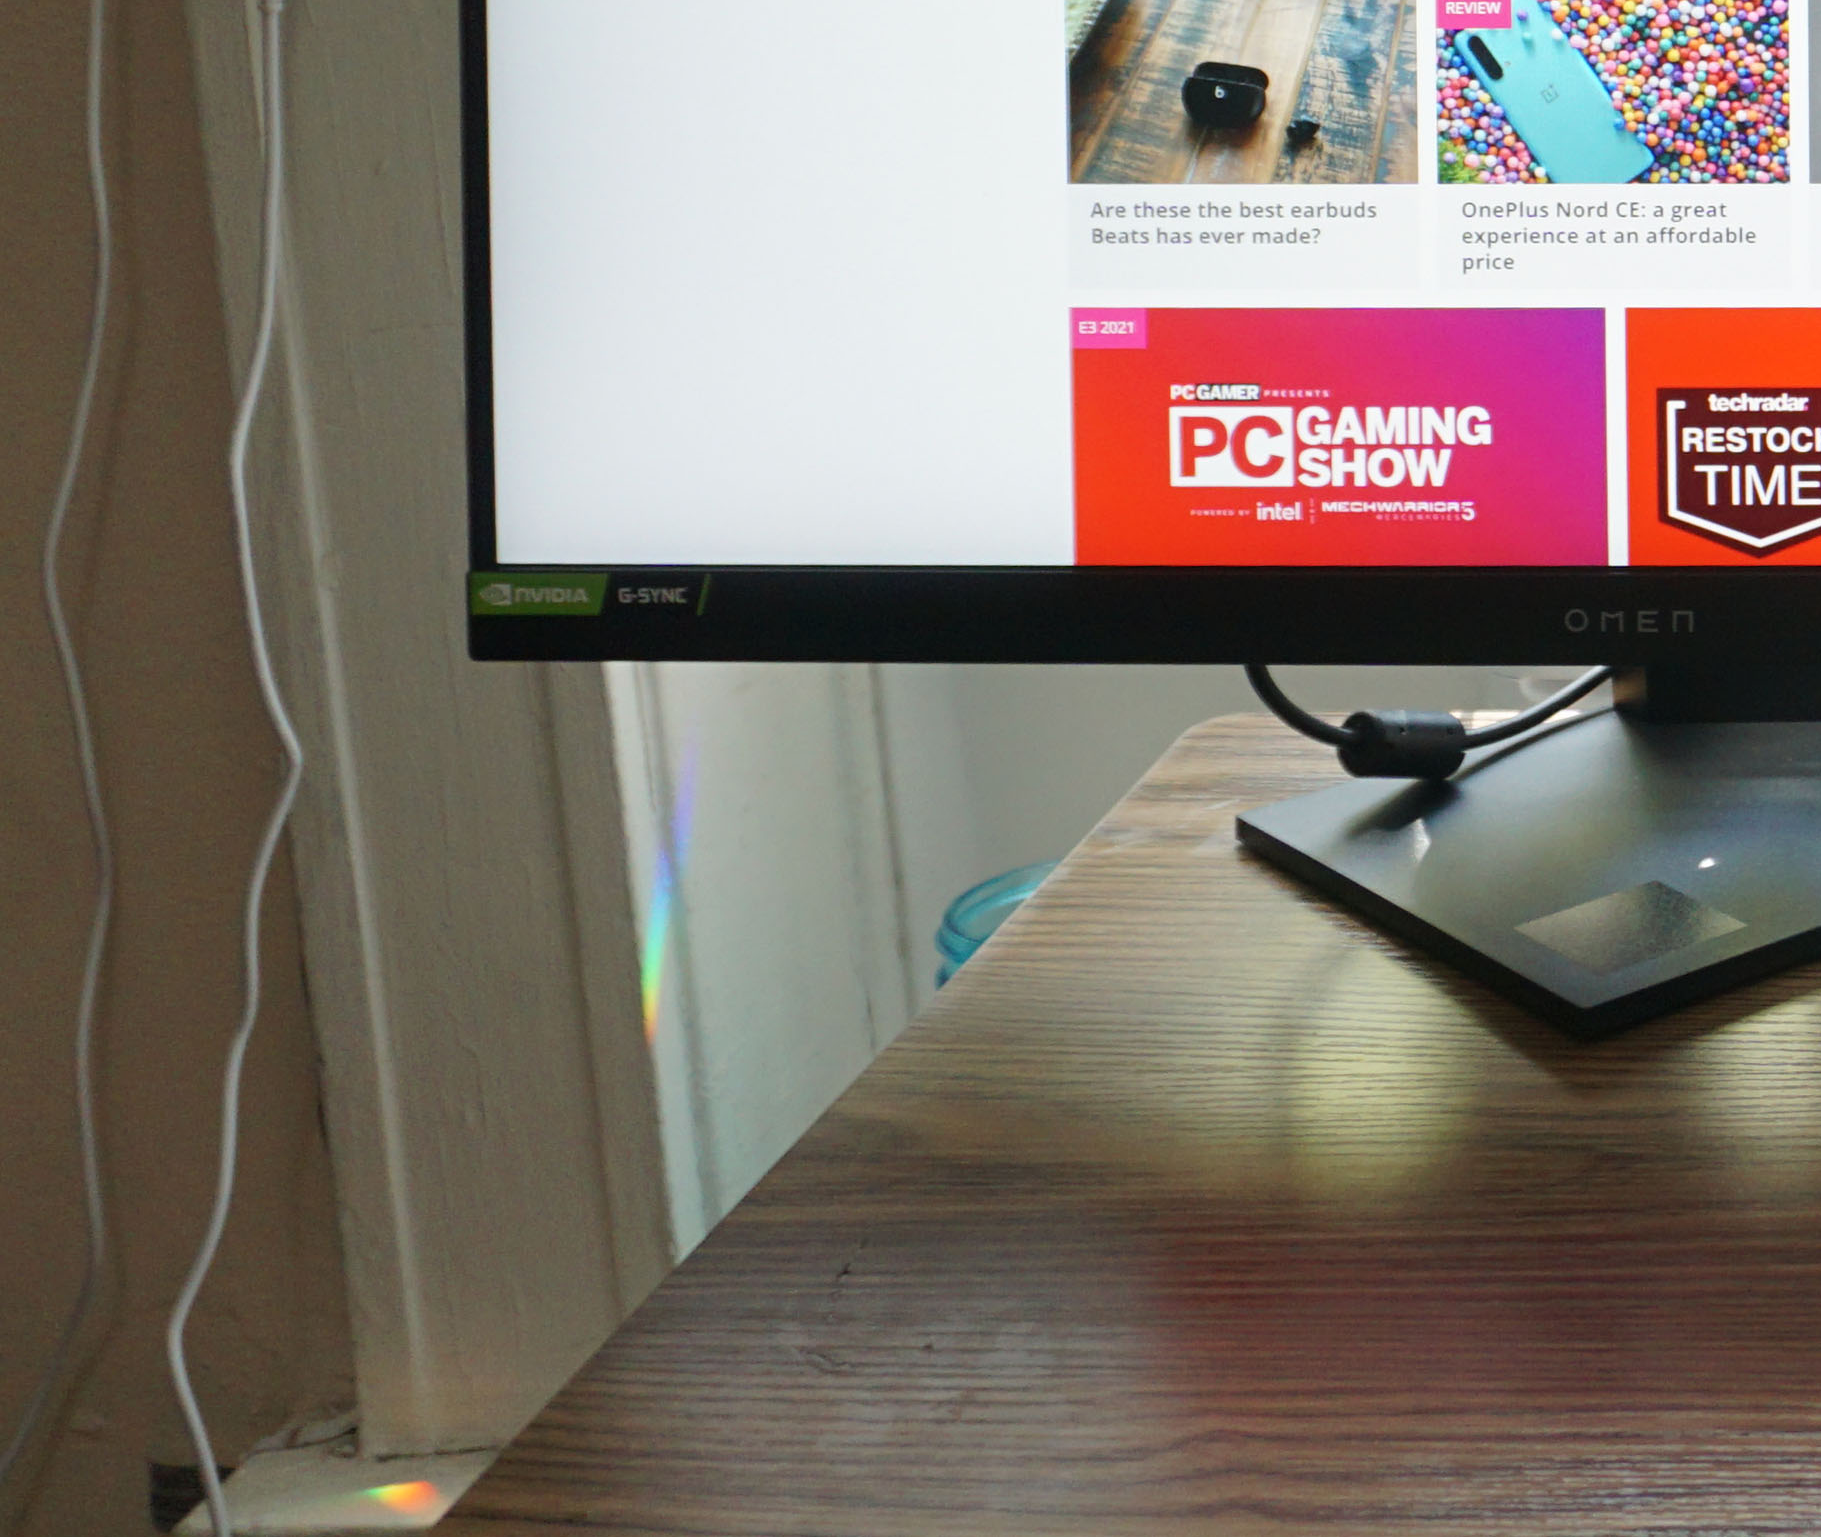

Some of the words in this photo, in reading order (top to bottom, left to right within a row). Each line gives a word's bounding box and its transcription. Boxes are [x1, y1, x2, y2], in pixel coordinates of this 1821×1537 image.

[1445, 1, 1502, 15] REVIEW
[1091, 201, 1126, 218] Are
[1133, 201, 1191, 218] these
[1198, 201, 1233, 218] the
[1239, 201, 1284, 218] best
[1290, 201, 1378, 218] earbuds
[1461, 201, 1549, 219] OnePlus
[1556, 201, 1609, 219] Nord
[1615, 201, 1647, 218] CE:
[1653, 206, 1664, 218] a
[1671, 203, 1727, 223] great
[1091, 227, 1150, 245] Beats
[1156, 227, 1193, 244] has
[1199, 232, 1245, 244] ever
[1252, 227, 1321, 244] made?
[1461, 227, 1579, 248] experience
[1585, 229, 1607, 244] at
[1613, 231, 1639, 243] an
[1646, 226, 1757, 244] affordable
[1461, 253, 1515, 275] price
[1078, 321, 1097, 335] E3
[1100, 321, 1136, 335] 2021
[1170, 384, 1196, 401] PC
[1196, 384, 1260, 401] GAMER
[1263, 389, 1331, 398] PRESENTS
[1179, 414, 1286, 479] PC
[1297, 406, 1493, 446] GAMING
[1297, 447, 1452, 489] SHOW
[1256, 501, 1304, 522] intel
[514, 587, 590, 604] NVIDIA
[617, 586, 688, 605] G-SYNC
[1564, 608, 1695, 633] OMEN
